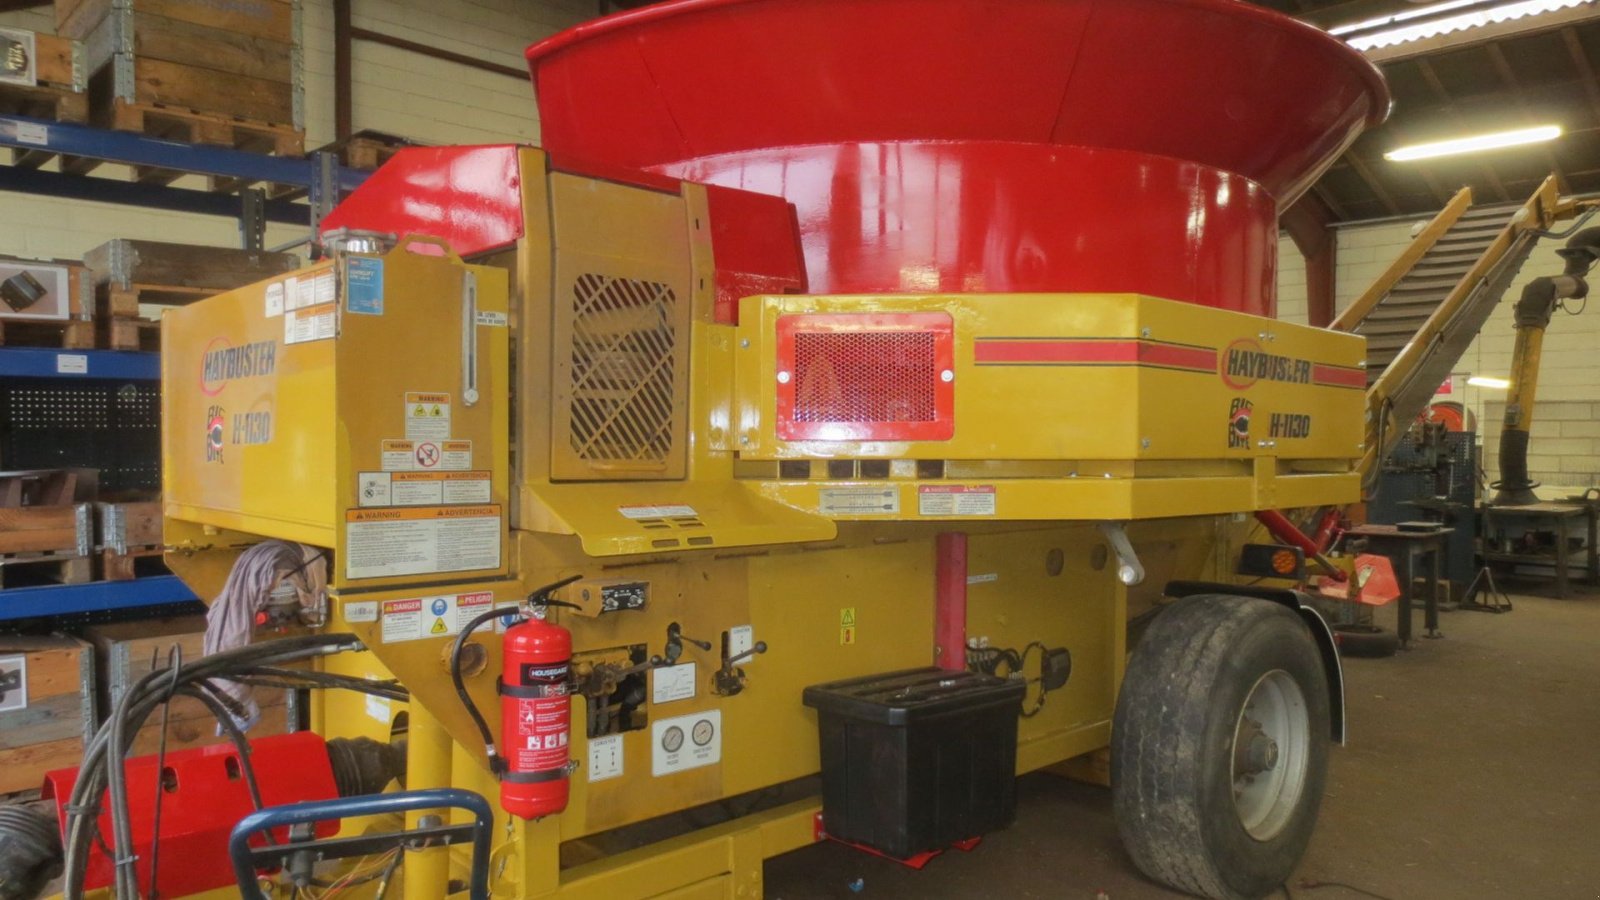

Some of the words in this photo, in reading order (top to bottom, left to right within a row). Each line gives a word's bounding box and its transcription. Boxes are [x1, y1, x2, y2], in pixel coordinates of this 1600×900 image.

[203, 340, 276, 382] HAYBUSTER
[232, 411, 272, 444] H-1130
[1270, 412, 1310, 438] H-1130
[365, 511, 401, 519] WARNING
[444, 507, 493, 516] ADVERTENCIA
[393, 600, 421, 611] DANGER
[464, 593, 492, 604] PELIGRO
